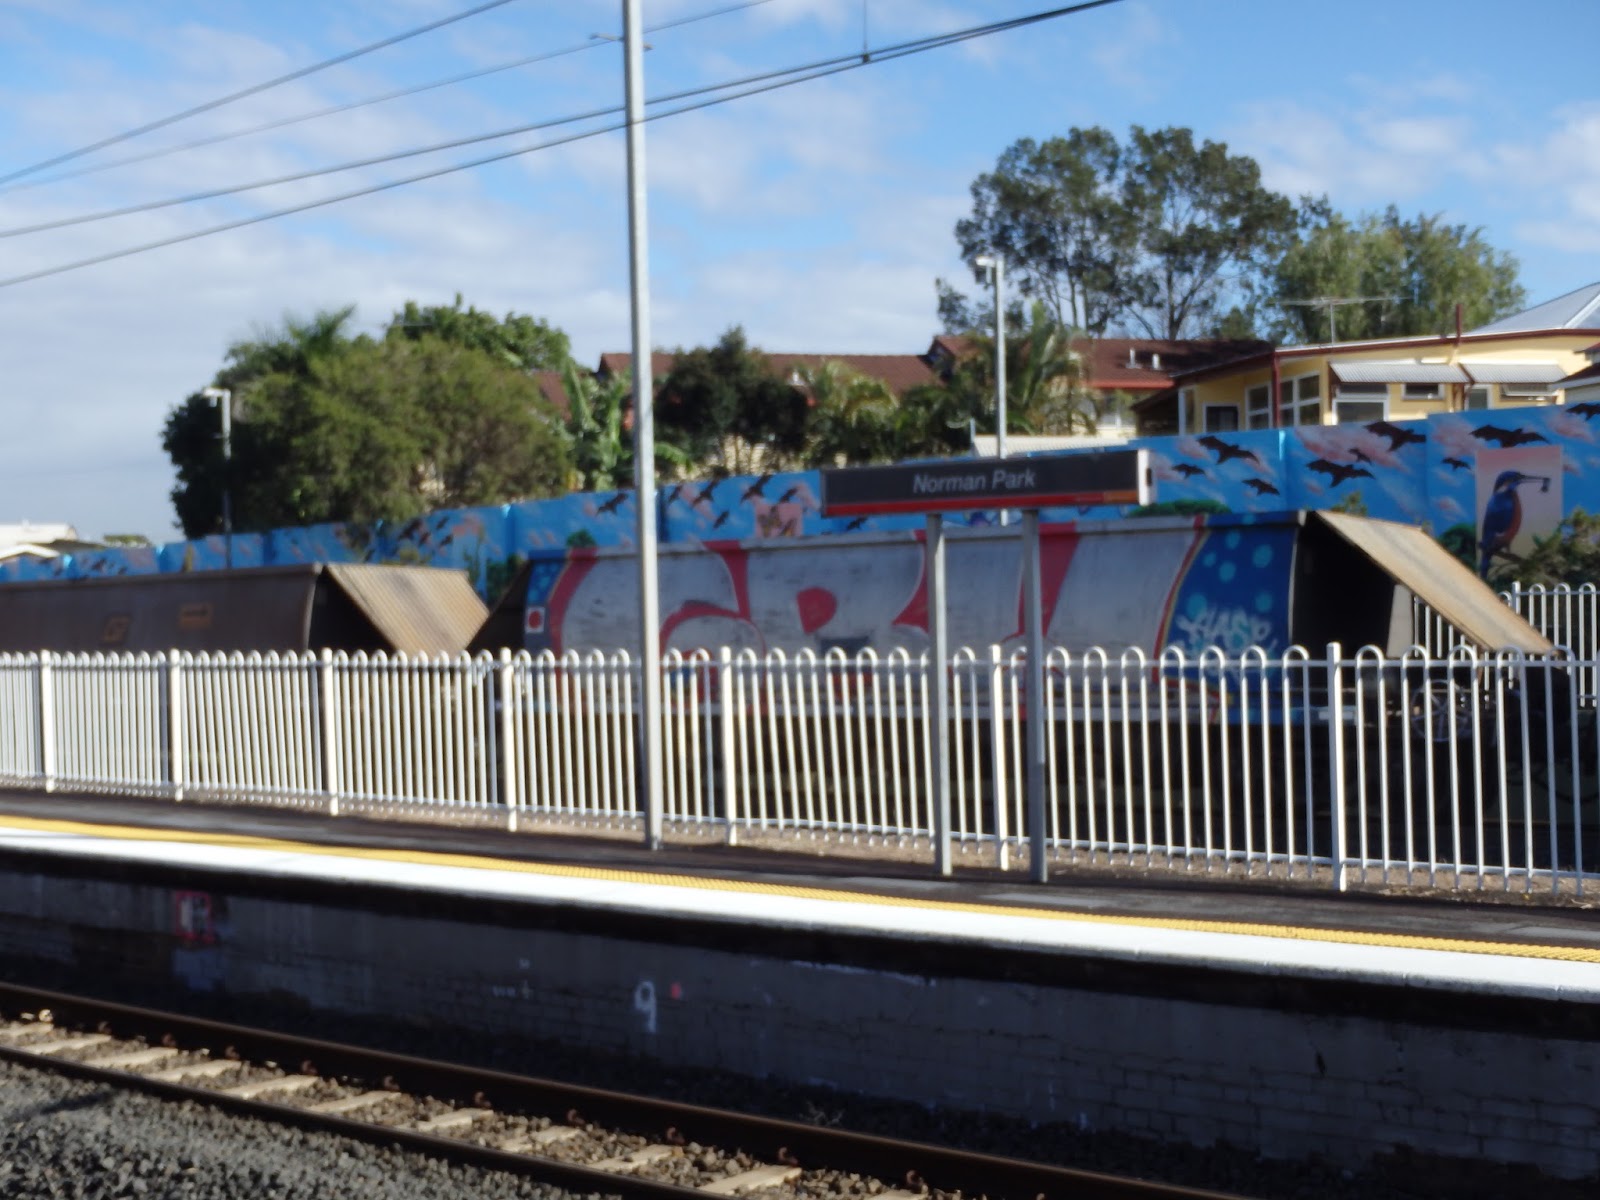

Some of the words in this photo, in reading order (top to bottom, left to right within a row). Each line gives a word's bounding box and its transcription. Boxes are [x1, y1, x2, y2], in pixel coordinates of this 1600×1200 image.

[912, 473, 986, 494] Norman
[991, 468, 1036, 490] Park
[634, 980, 657, 1033] 9
